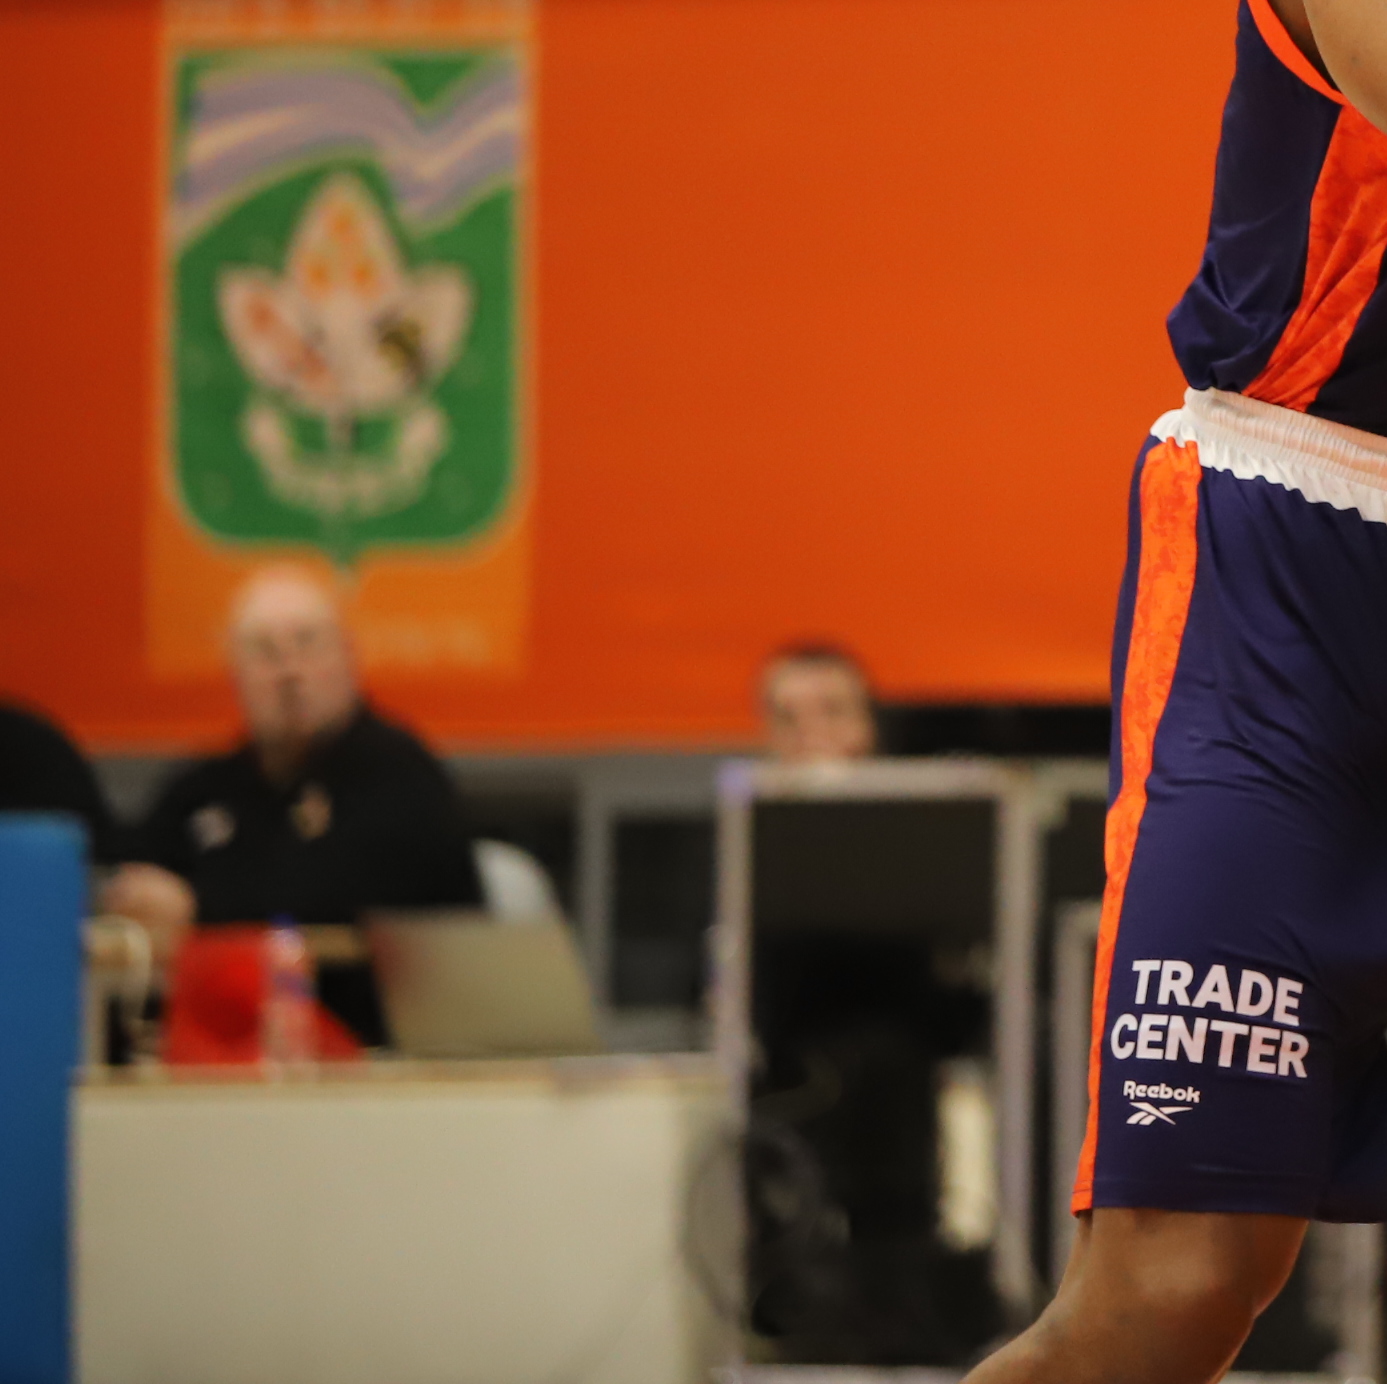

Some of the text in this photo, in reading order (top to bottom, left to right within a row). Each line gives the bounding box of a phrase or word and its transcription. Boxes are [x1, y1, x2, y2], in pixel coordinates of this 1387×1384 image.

[1131, 958, 1304, 1027] TRADE
[1109, 1012, 1310, 1079] CENTER
[1123, 1080, 1200, 1104] Reebok
